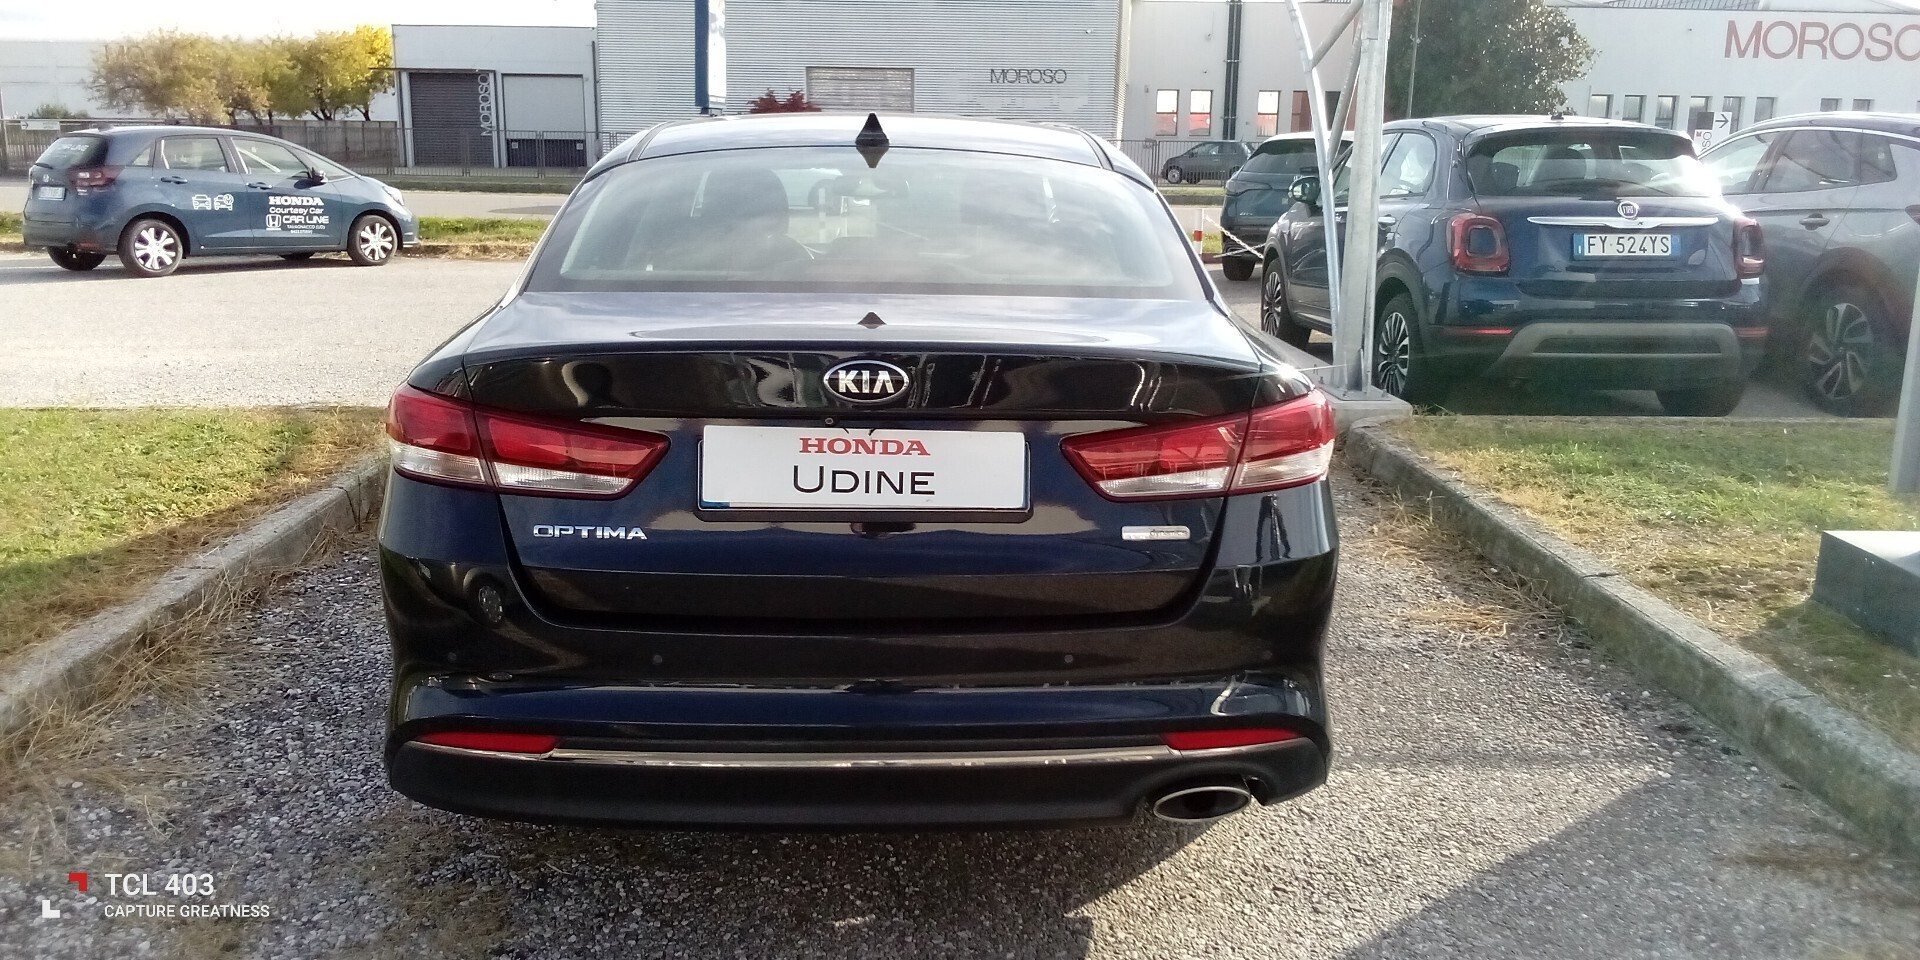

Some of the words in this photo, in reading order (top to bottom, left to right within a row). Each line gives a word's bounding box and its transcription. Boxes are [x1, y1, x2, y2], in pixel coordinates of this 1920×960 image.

[1724, 20, 1920, 62] MOROSO
[990, 68, 1067, 84] MOROSO
[478, 74, 493, 136] MOROSO
[268, 195, 325, 206] HONDA
[269, 206, 308, 215] Courtesy
[282, 215, 305, 224] CAR
[306, 215, 330, 224] LINE
[837, 370, 895, 394] KIA
[799, 437, 931, 456] HONDA
[793, 465, 936, 496] UDINE
[533, 524, 648, 540] OPTIMA
